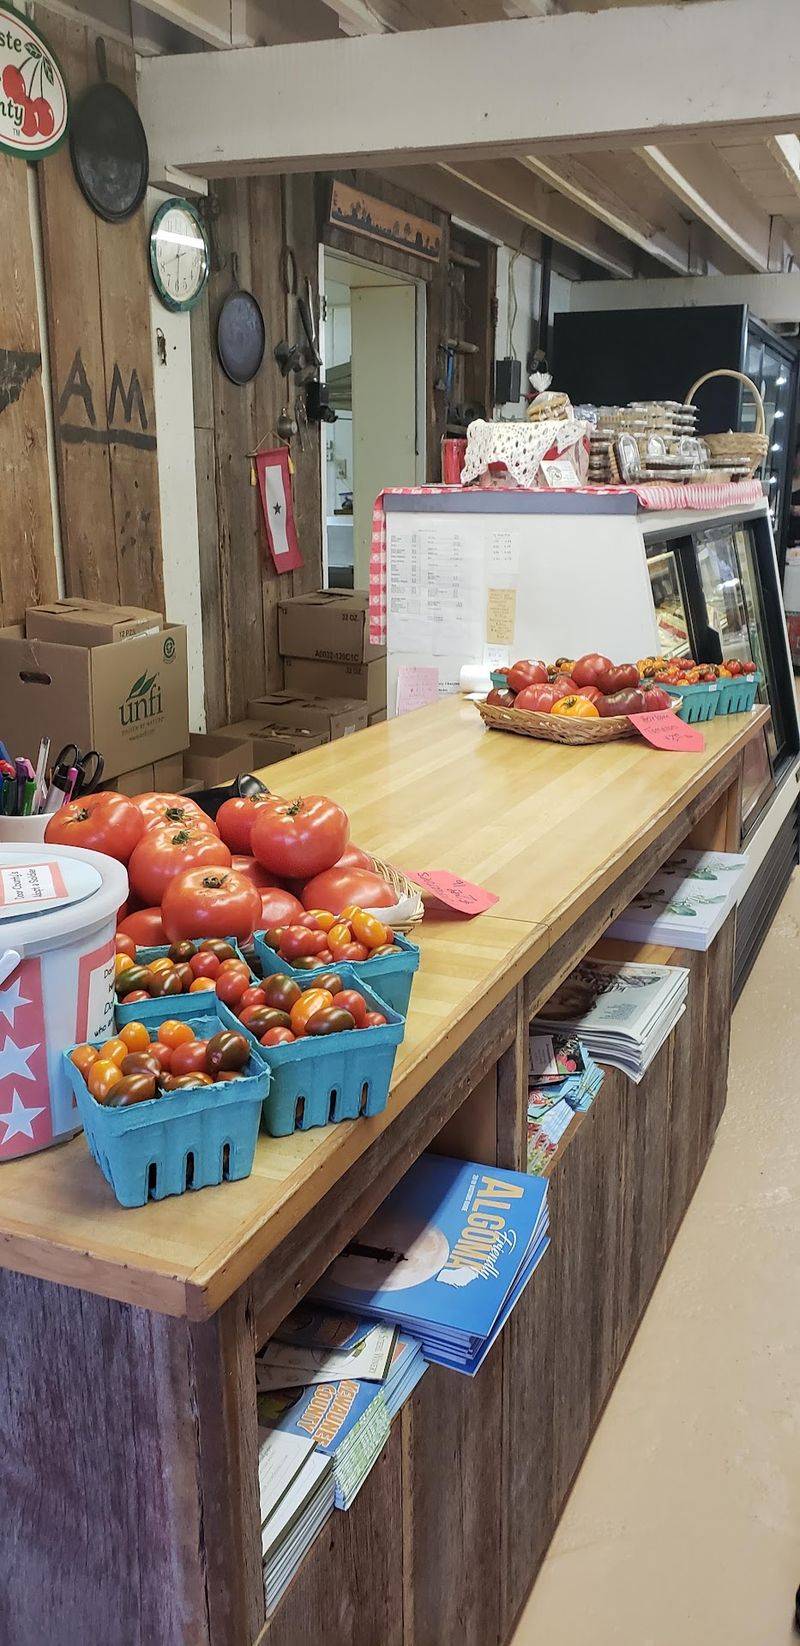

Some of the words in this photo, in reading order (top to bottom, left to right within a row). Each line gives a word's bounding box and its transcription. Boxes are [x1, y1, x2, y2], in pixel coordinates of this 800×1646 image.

[119, 683, 163, 726] unfi
[444, 1176, 524, 1271] ALGOMA
[478, 1229, 517, 1280] Friendly
[297, 1384, 337, 1435] COUNTY
